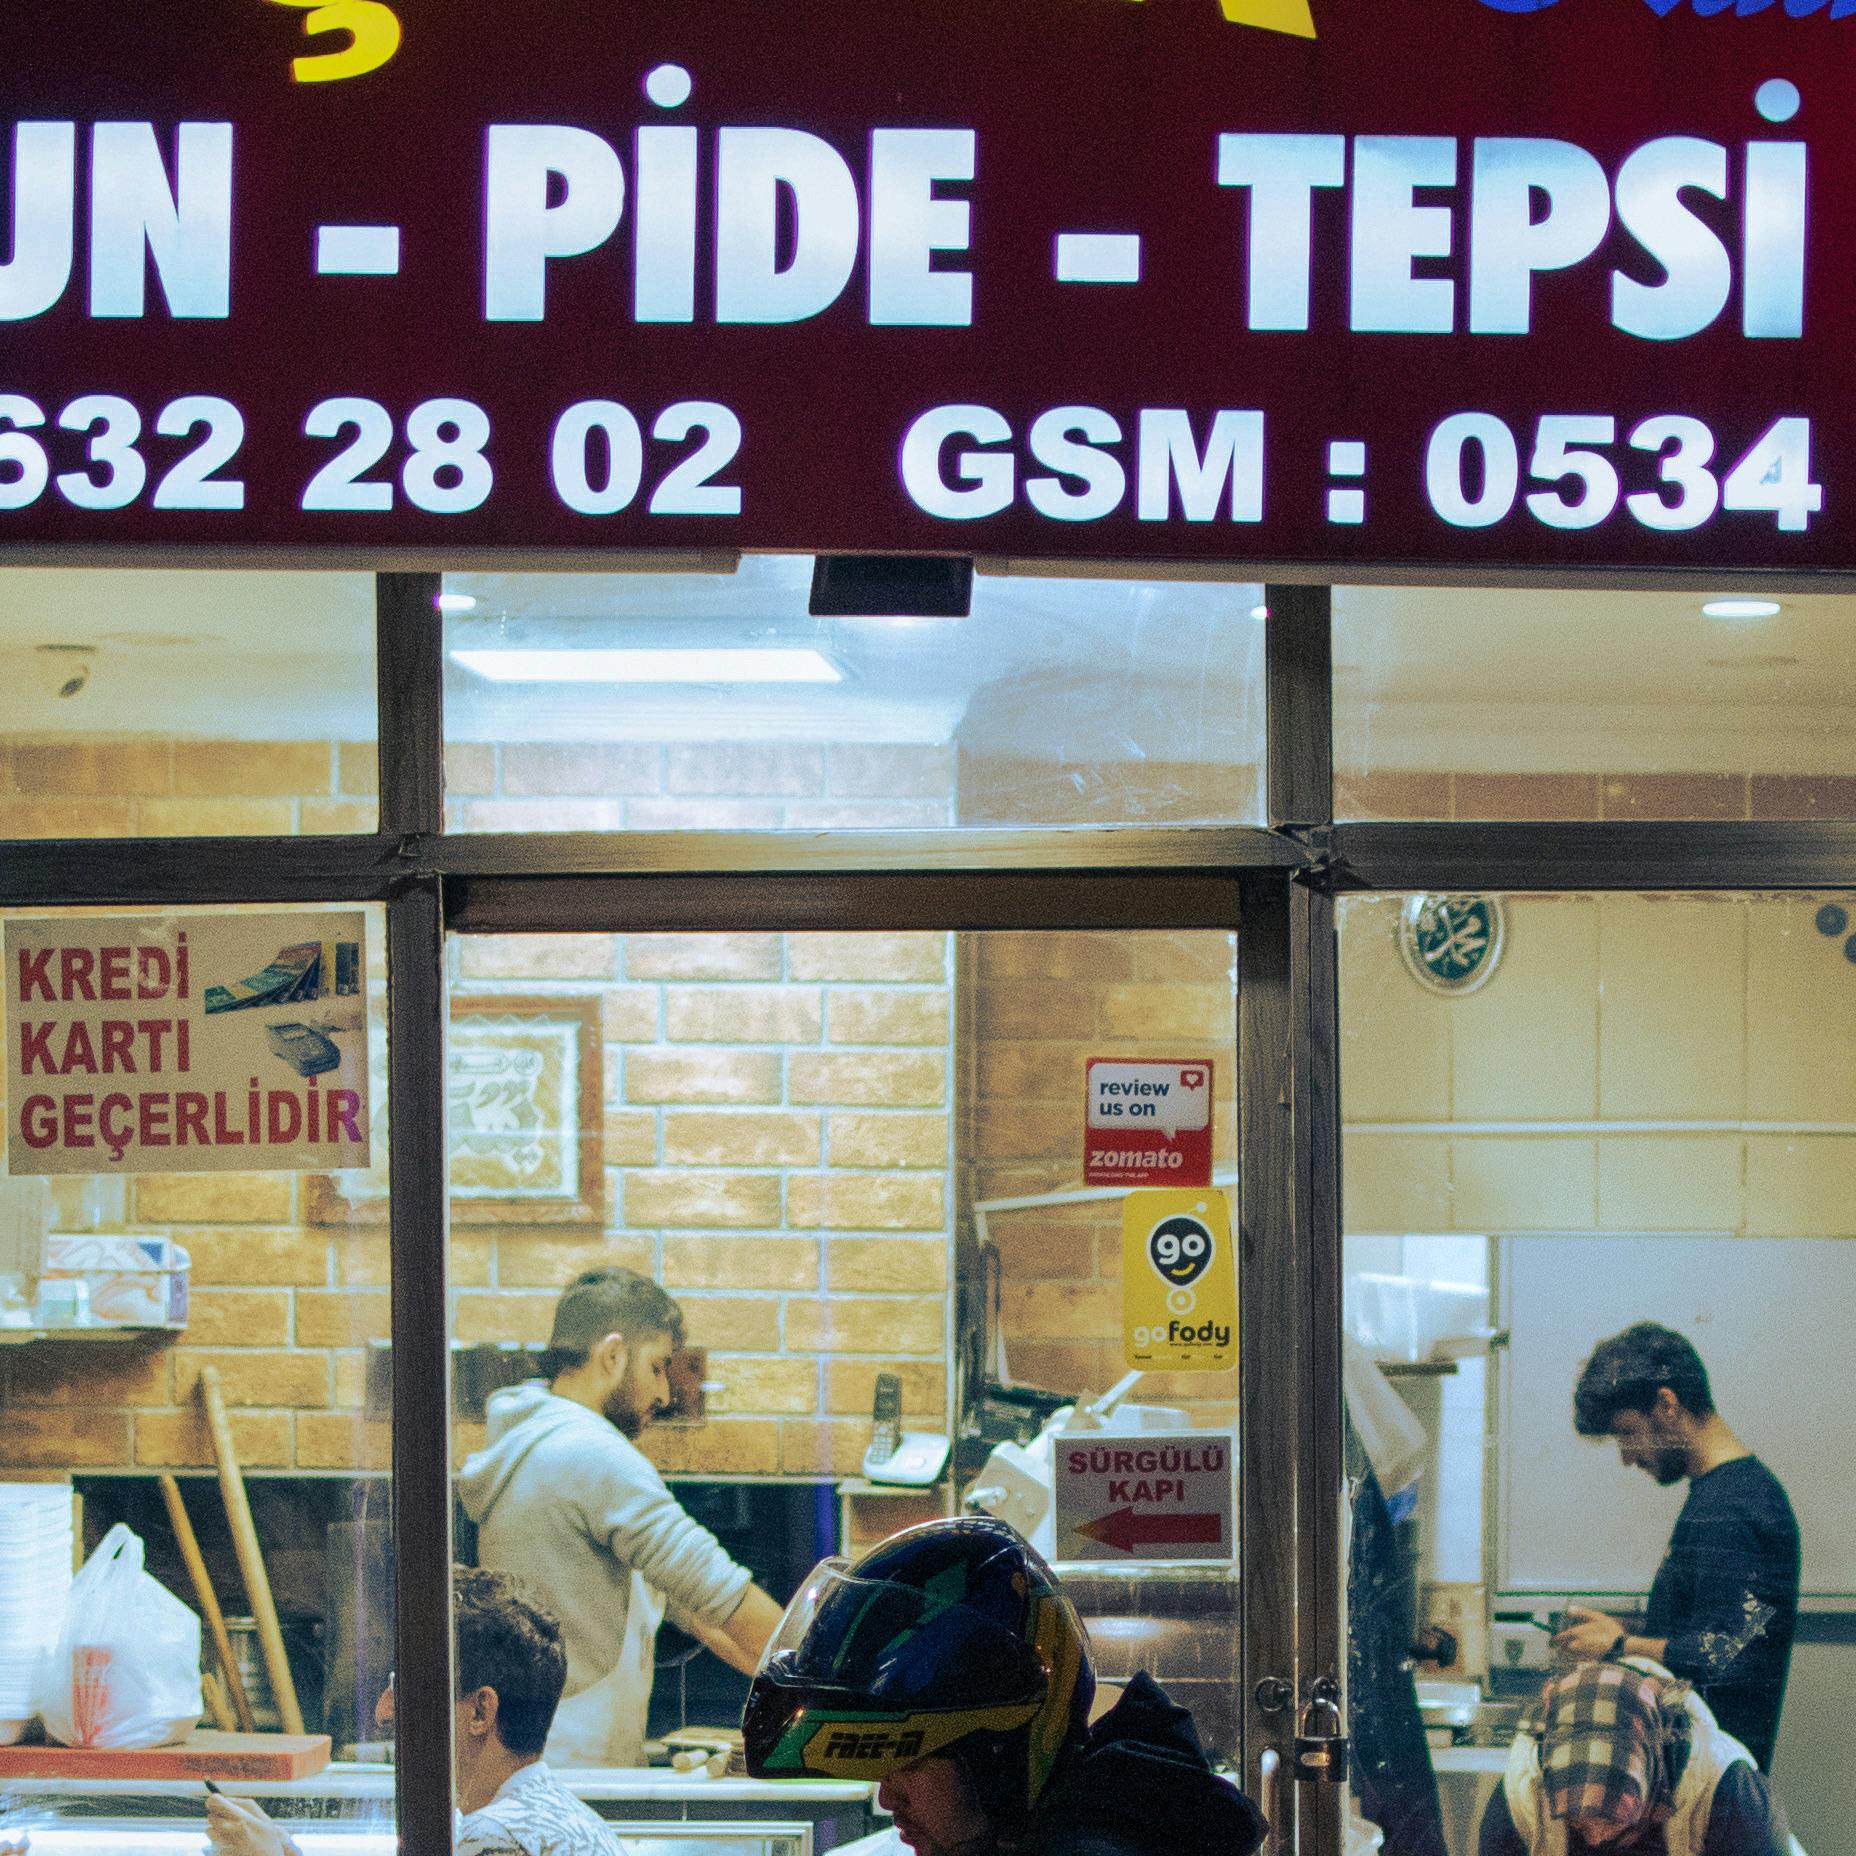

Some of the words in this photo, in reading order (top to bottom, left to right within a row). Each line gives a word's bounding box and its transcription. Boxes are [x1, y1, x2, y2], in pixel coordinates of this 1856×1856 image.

[484, 63, 976, 327] PİDE
[1217, 78, 1807, 342] TEPSİ
[301, 396, 494, 515] 28
[551, 399, 743, 516] 02
[900, 403, 1265, 523] GSM
[1425, 411, 1823, 532] 0534
[18, 931, 189, 1003] KREDİ
[19, 1017, 191, 1075] KARTI
[1099, 1078, 1171, 1098] review
[19, 1075, 364, 1162] GEÇERLİDİR
[1099, 1101, 1124, 1118] us
[1129, 1101, 1157, 1118] on
[1089, 1147, 1184, 1170] zomato
[1156, 1233, 1206, 1266] go
[1067, 1443, 1225, 1475] SÜRGÜLÜ
[1107, 1478, 1187, 1504] KAPI
